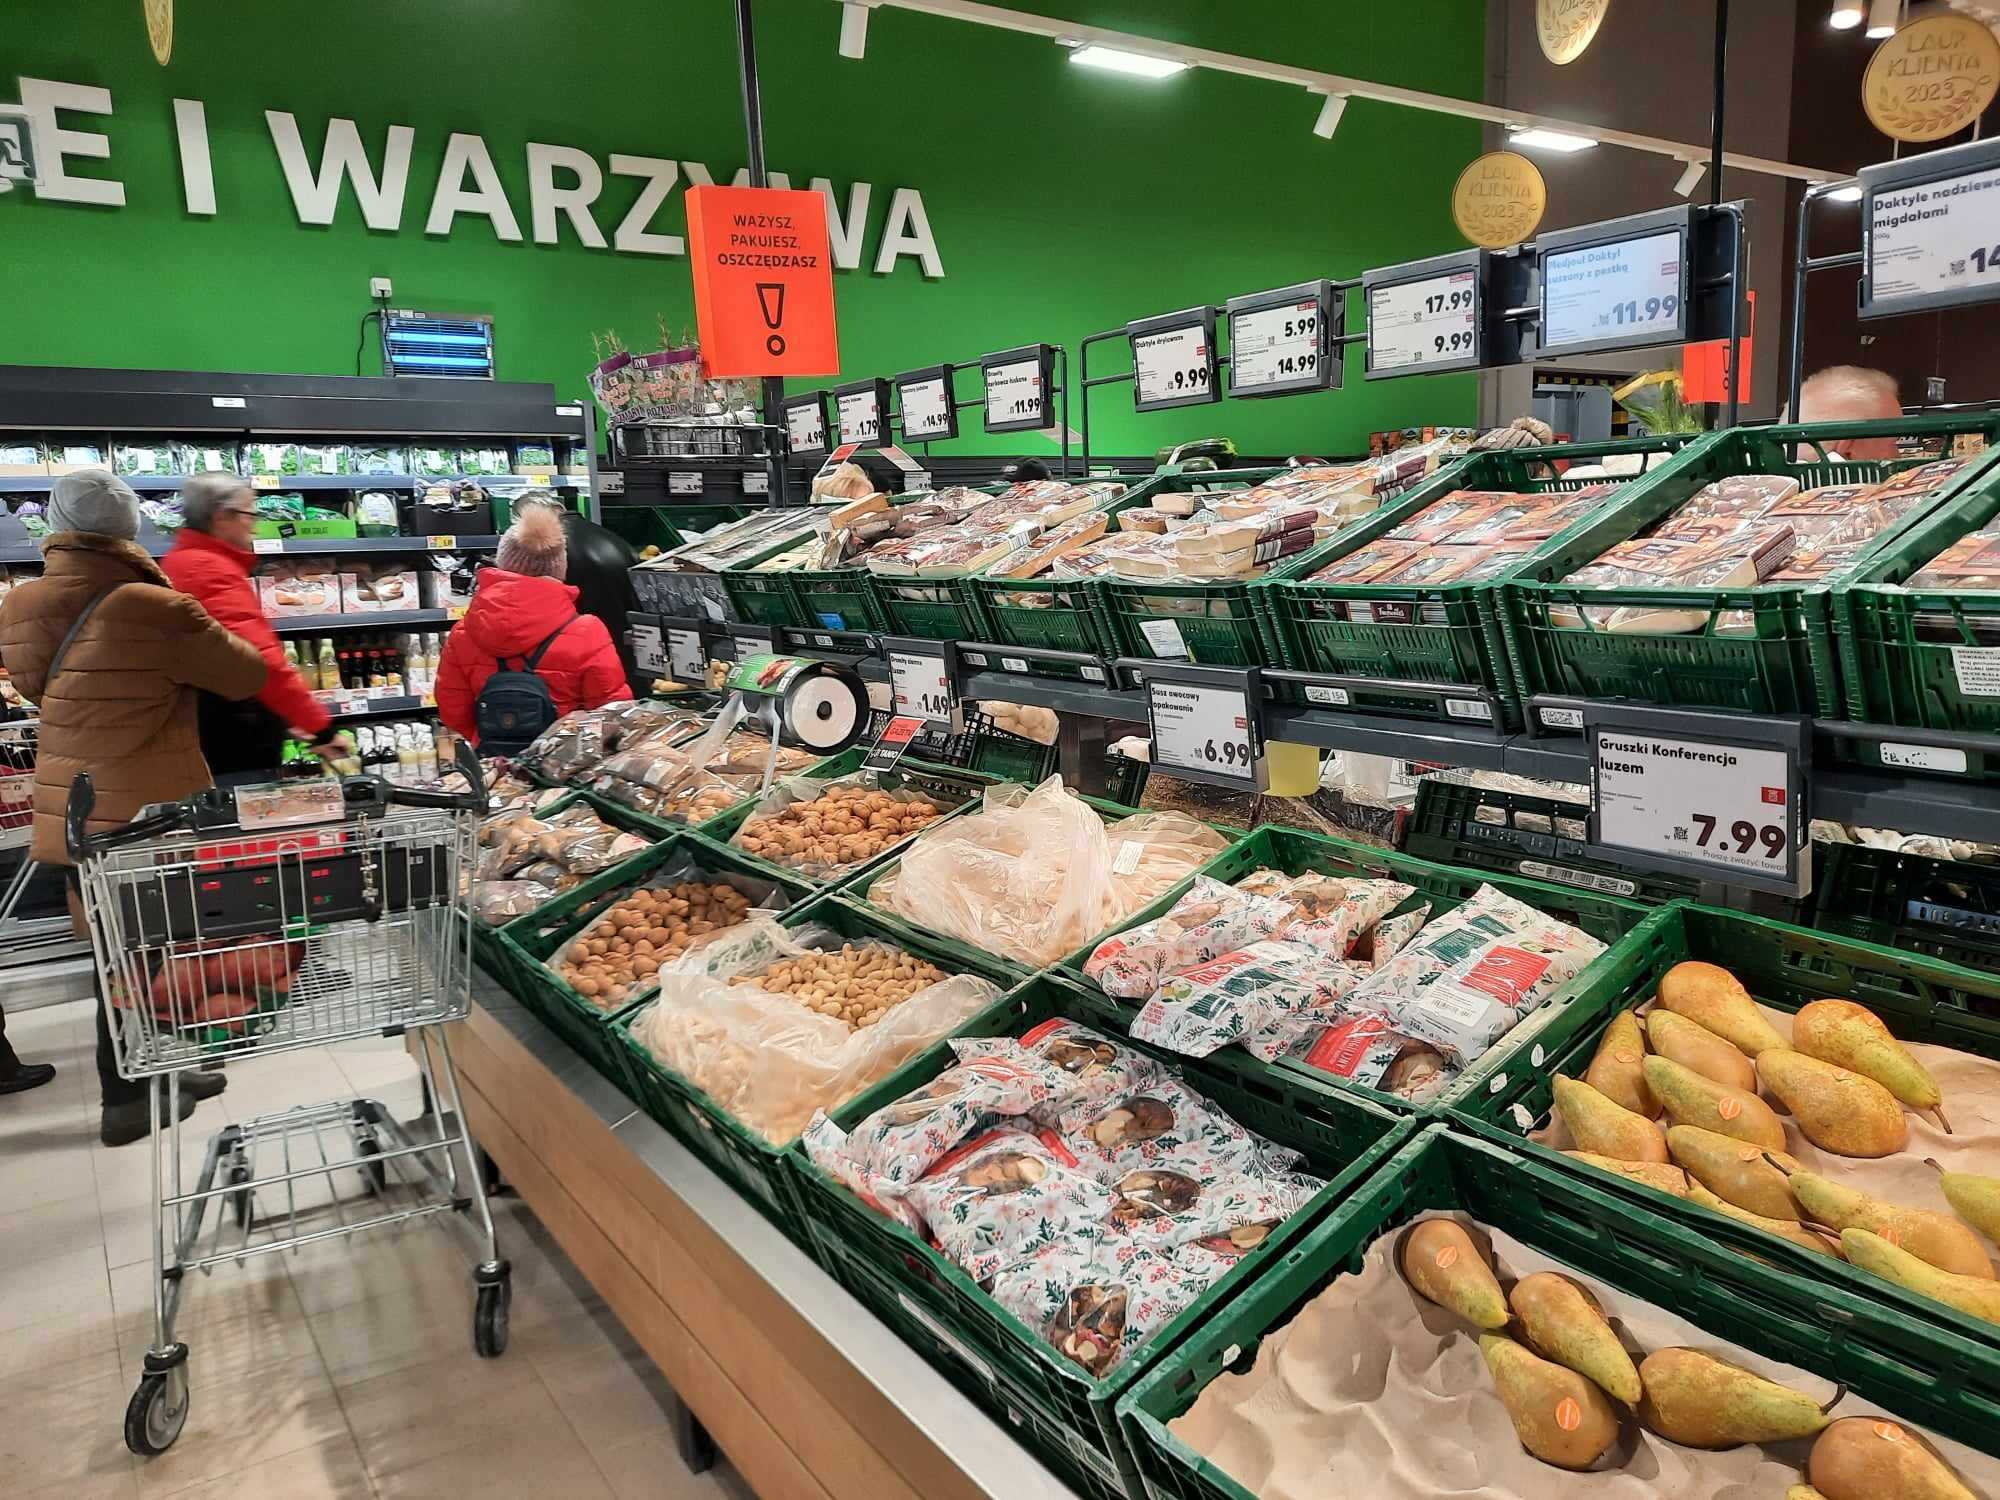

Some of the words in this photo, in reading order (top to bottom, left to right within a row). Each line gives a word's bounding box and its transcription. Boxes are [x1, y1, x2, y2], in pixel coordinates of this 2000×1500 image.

[1907, 31, 1966, 53] LAUR
[1888, 54, 1980, 77] KLIENTA
[1905, 82, 1955, 103] 2023
[173, 98, 217, 215] I
[1482, 162, 1521, 180] LAUR
[1469, 182, 1531, 198] KLIENTA
[1482, 204, 1514, 218] 2023
[1874, 192, 1929, 212] Daktyle
[734, 213, 796, 231] WAŻYSZ,
[1874, 204, 1949, 229] migdałami
[731, 234, 801, 249] PAKUJESZ,
[718, 253, 817, 269] OSZCZĘDZASZ
[1588, 248, 1621, 264] Daktyl
[1425, 289, 1473, 315] 17.99
[1612, 294, 1678, 325] 11.99
[1284, 317, 1316, 337] 5.99
[1434, 331, 1473, 353] 9.99
[1277, 354, 1316, 374] 14.99
[1174, 367, 1208, 390] 9.99
[1014, 398, 1041, 414] 11.99
[859, 419, 878, 436] 1.79
[926, 413, 948, 427] 14.99
[807, 430, 824, 445] 4.99
[921, 692, 949, 716] 1.49
[1151, 687, 1168, 697] Susz
[1168, 691, 1200, 702] owocowy
[1152, 702, 1194, 713] opakowanie
[1204, 739, 1250, 767] 6.99
[1600, 737, 1649, 755] Gruszki
[1651, 743, 1738, 767] Konferencja
[1600, 756, 1645, 775] luzem
[1692, 813, 1787, 859] 7.99
[1703, 849, 1728, 863] Proszę
